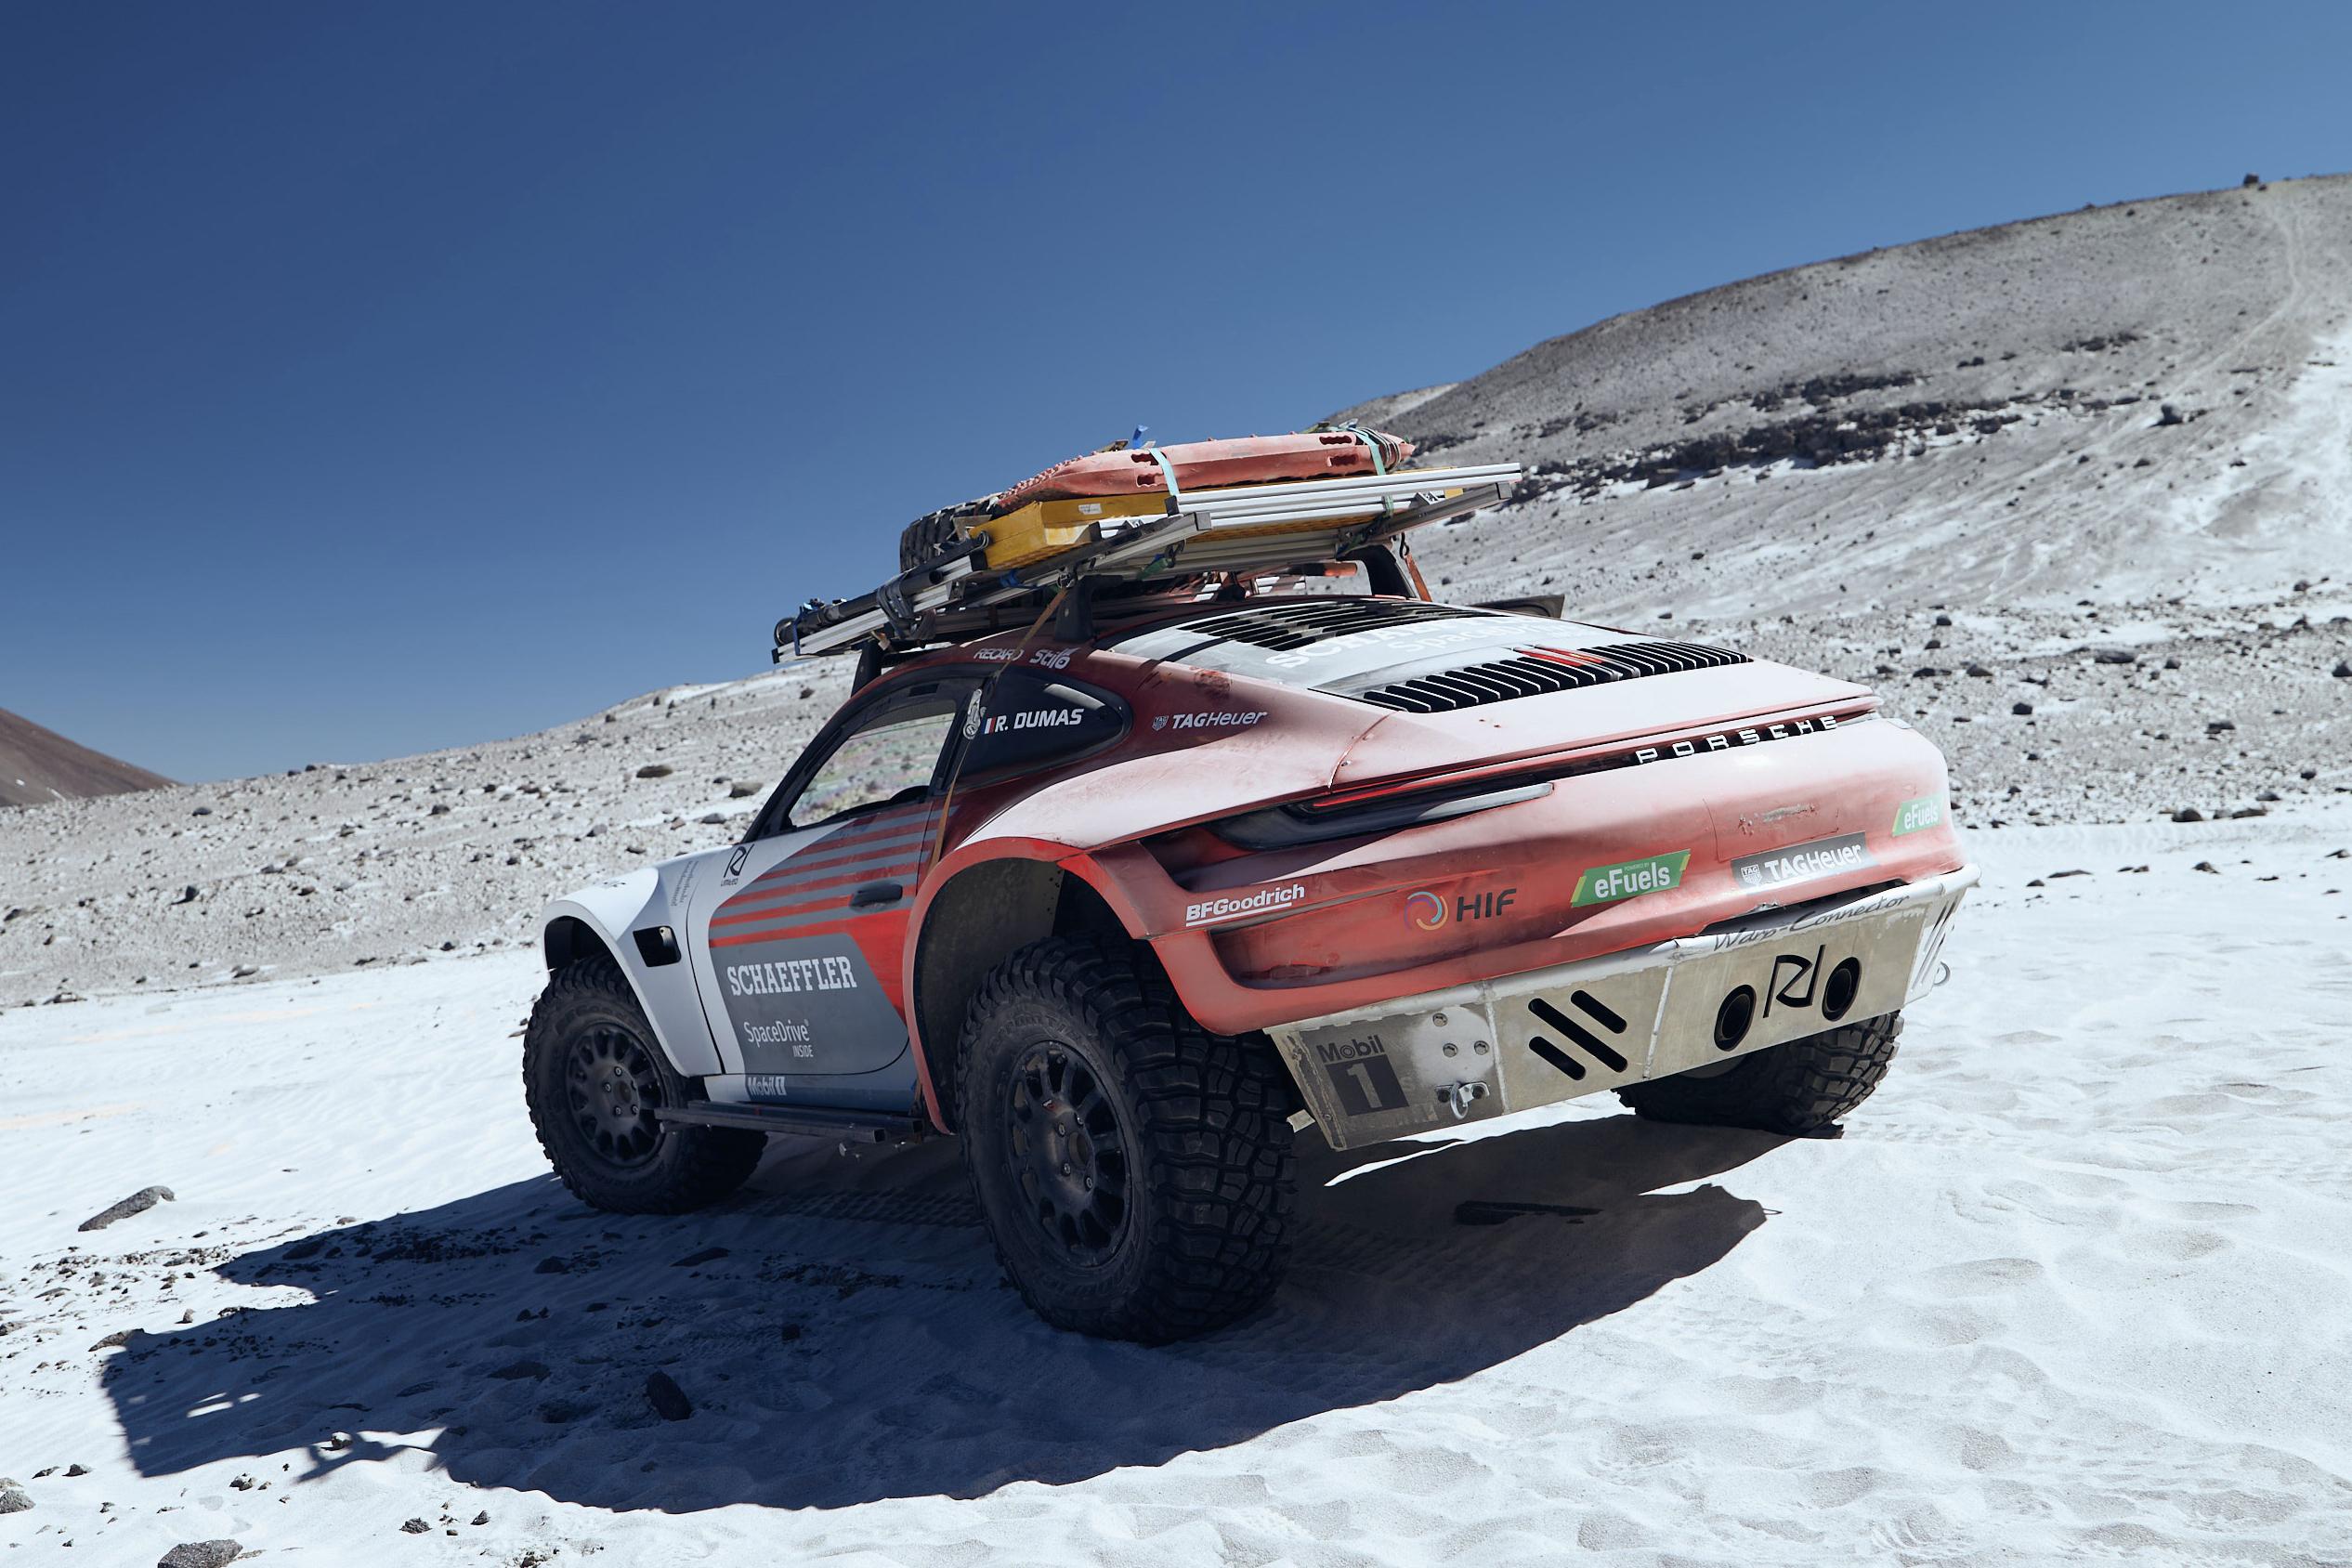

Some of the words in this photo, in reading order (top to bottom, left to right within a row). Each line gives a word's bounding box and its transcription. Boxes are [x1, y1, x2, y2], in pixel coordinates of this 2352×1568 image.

[995, 715, 1008, 733] R.
[1013, 709, 1085, 729] DUMAS
[1172, 712, 1268, 729] TAGHeuer
[1636, 715, 1838, 764] PORSCHE
[1903, 801, 1940, 830] eFuels
[1594, 862, 1671, 898] eFuels
[1765, 844, 1862, 882] TAGHeuer
[1186, 884, 1305, 921] BFGoodrich
[1457, 888, 1517, 922] HIF
[727, 956, 857, 996] SCHAEFFLER
[792, 1045, 814, 1058] INSIDE
[1316, 1034, 1386, 1065] Mobil
[747, 1077, 776, 1096] Mobil
[1347, 1063, 1383, 1108] 1
